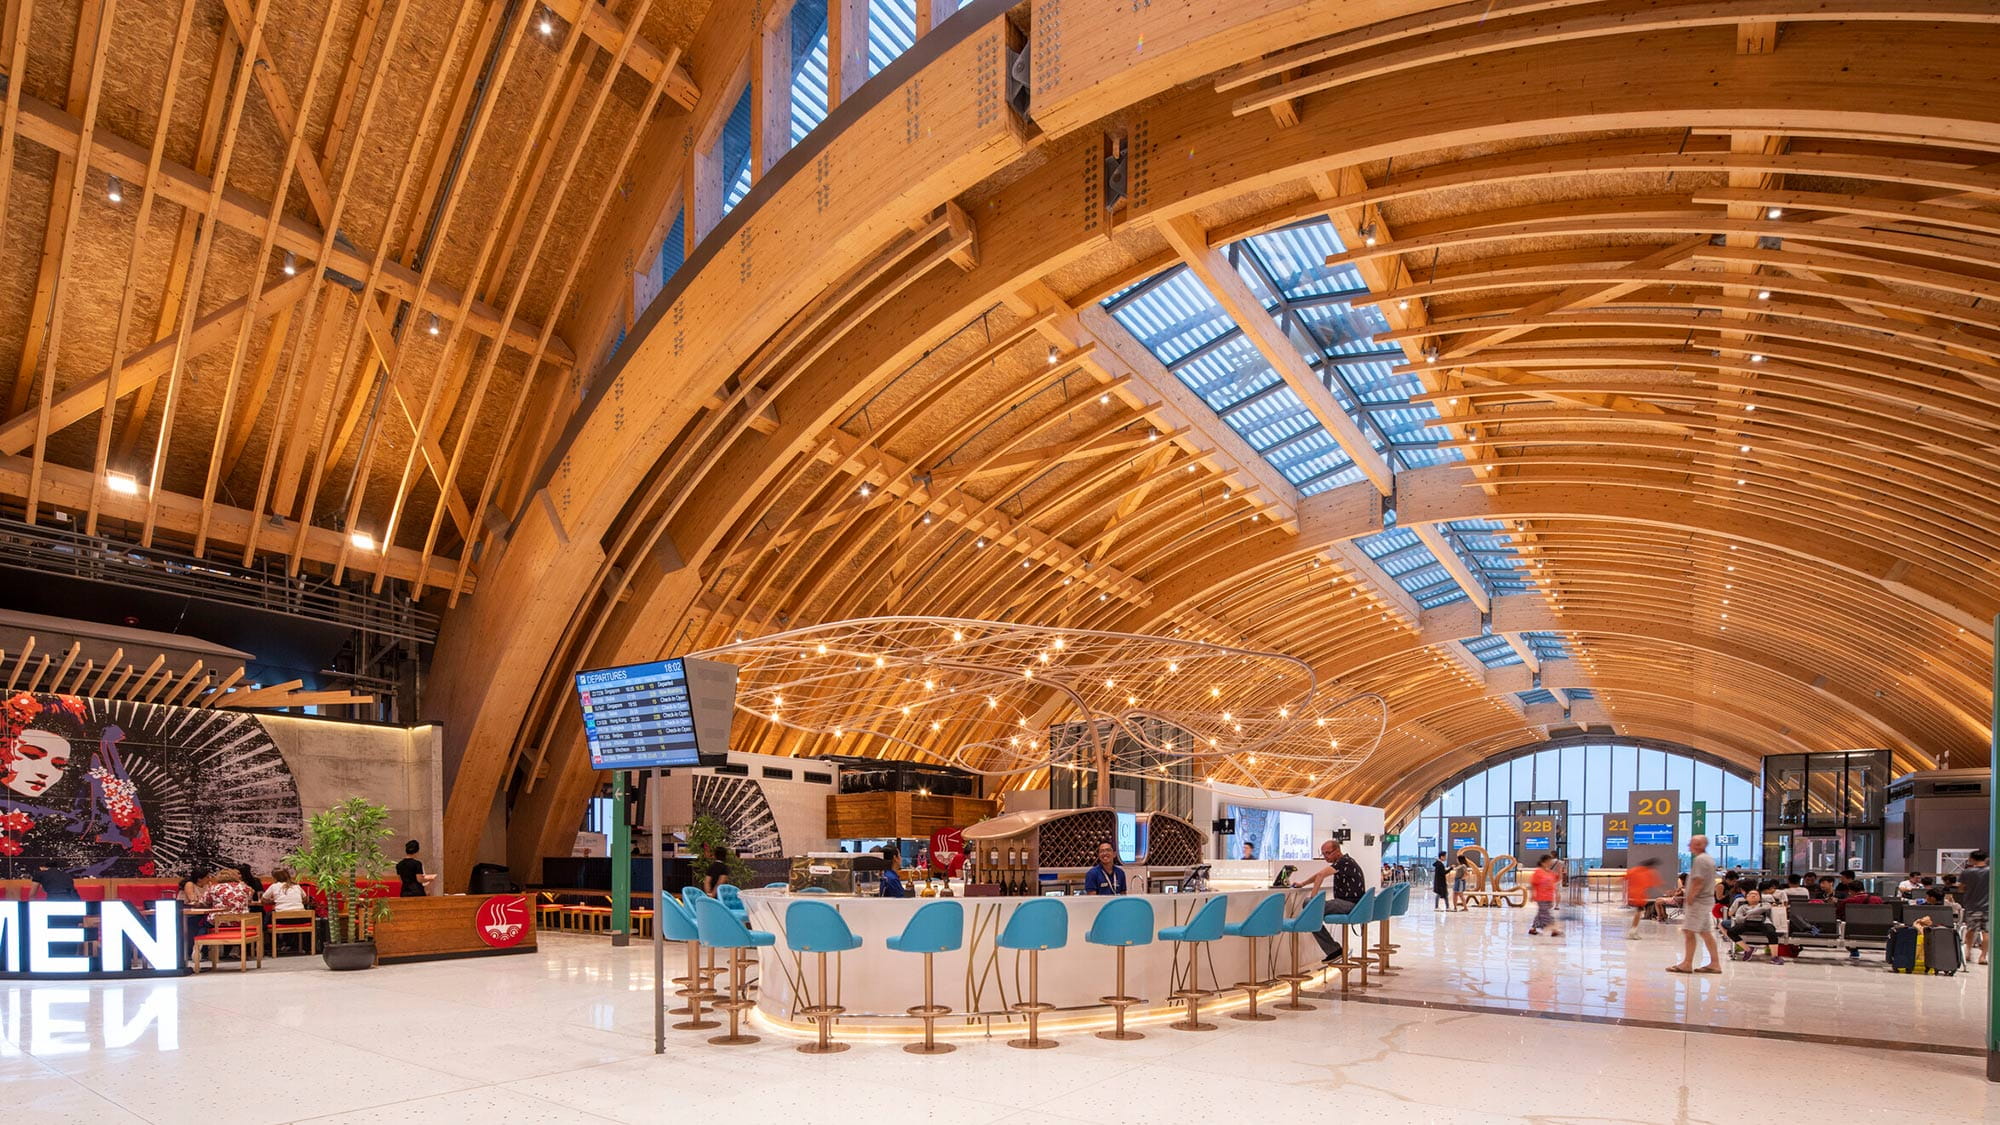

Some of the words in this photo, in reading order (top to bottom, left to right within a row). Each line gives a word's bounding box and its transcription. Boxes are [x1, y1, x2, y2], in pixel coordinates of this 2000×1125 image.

[664, 662, 681, 672] 18:02
[587, 671, 627, 684] DEPARTURES
[1638, 798, 1672, 815] 20
[1450, 822, 1478, 833] 22A
[1522, 821, 1552, 832] 22B
[1608, 819, 1629, 831] 21
[0, 900, 178, 972] EN
